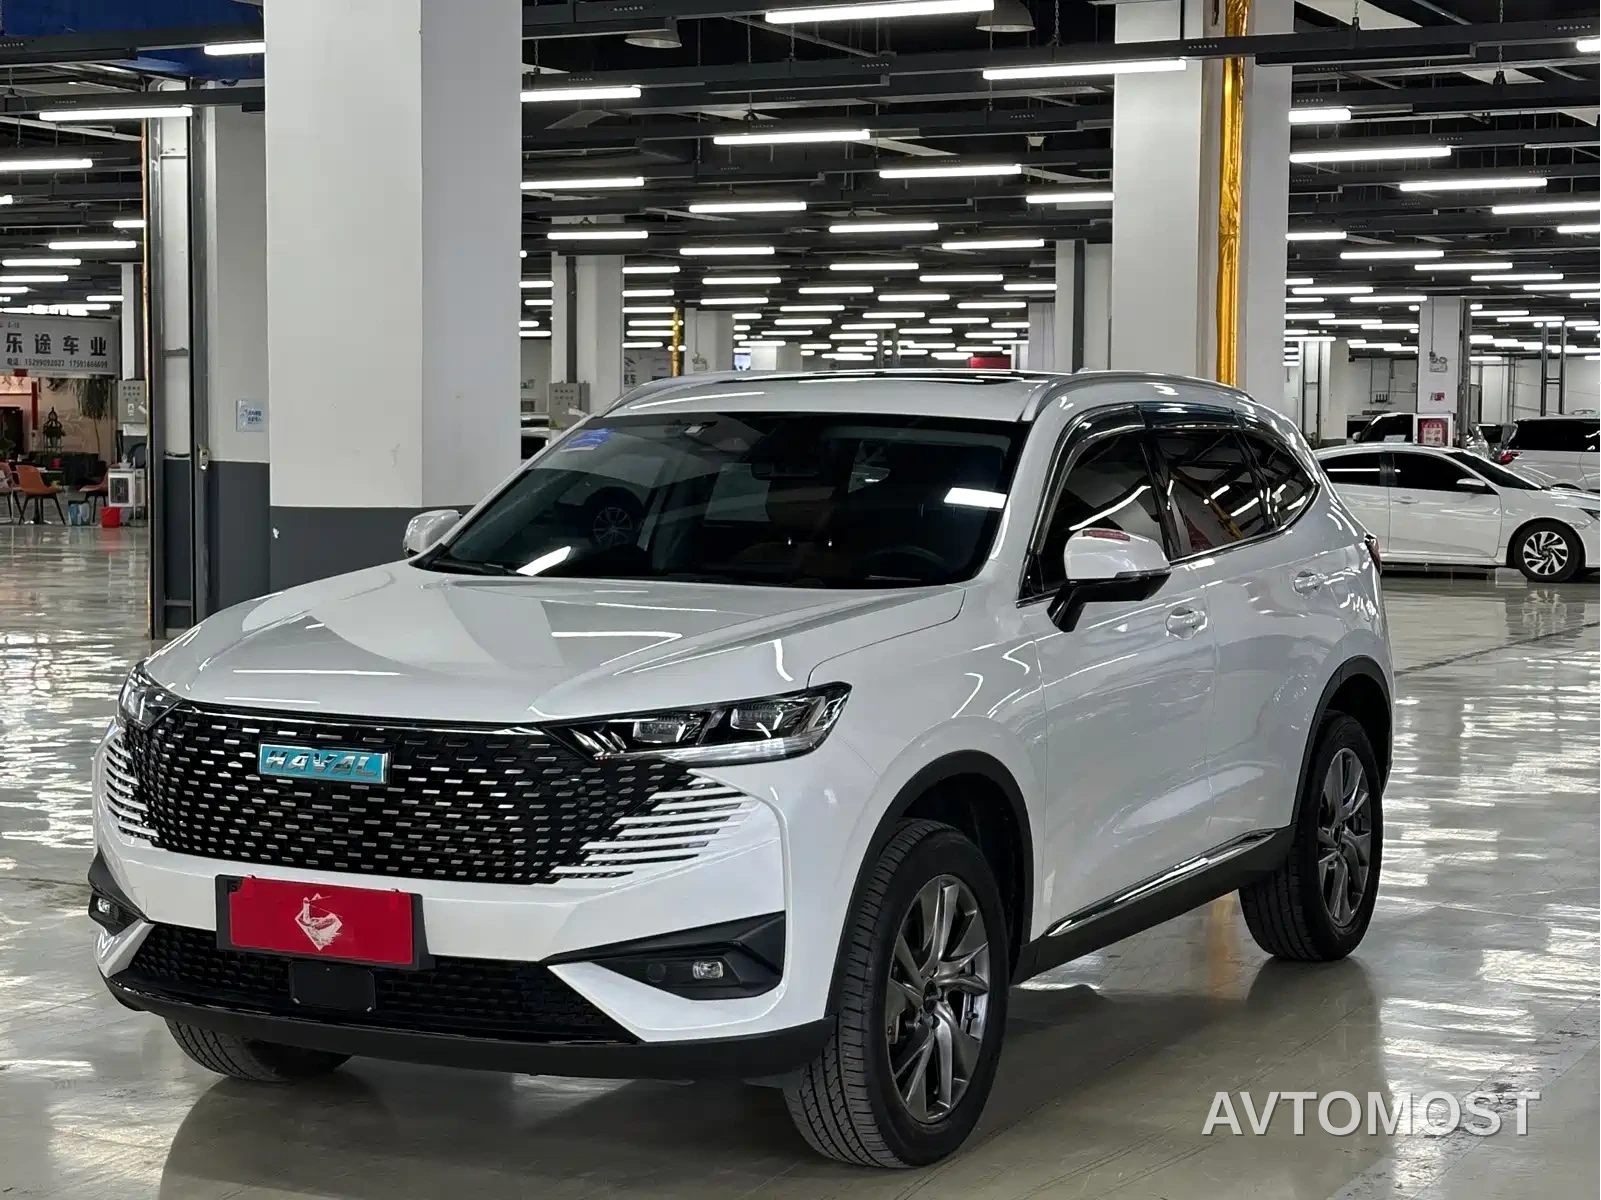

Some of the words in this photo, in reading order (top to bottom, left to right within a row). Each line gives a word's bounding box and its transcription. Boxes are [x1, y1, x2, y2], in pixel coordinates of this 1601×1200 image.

[6, 333, 107, 356] 乐途车业
[266, 750, 376, 776] HAVAL
